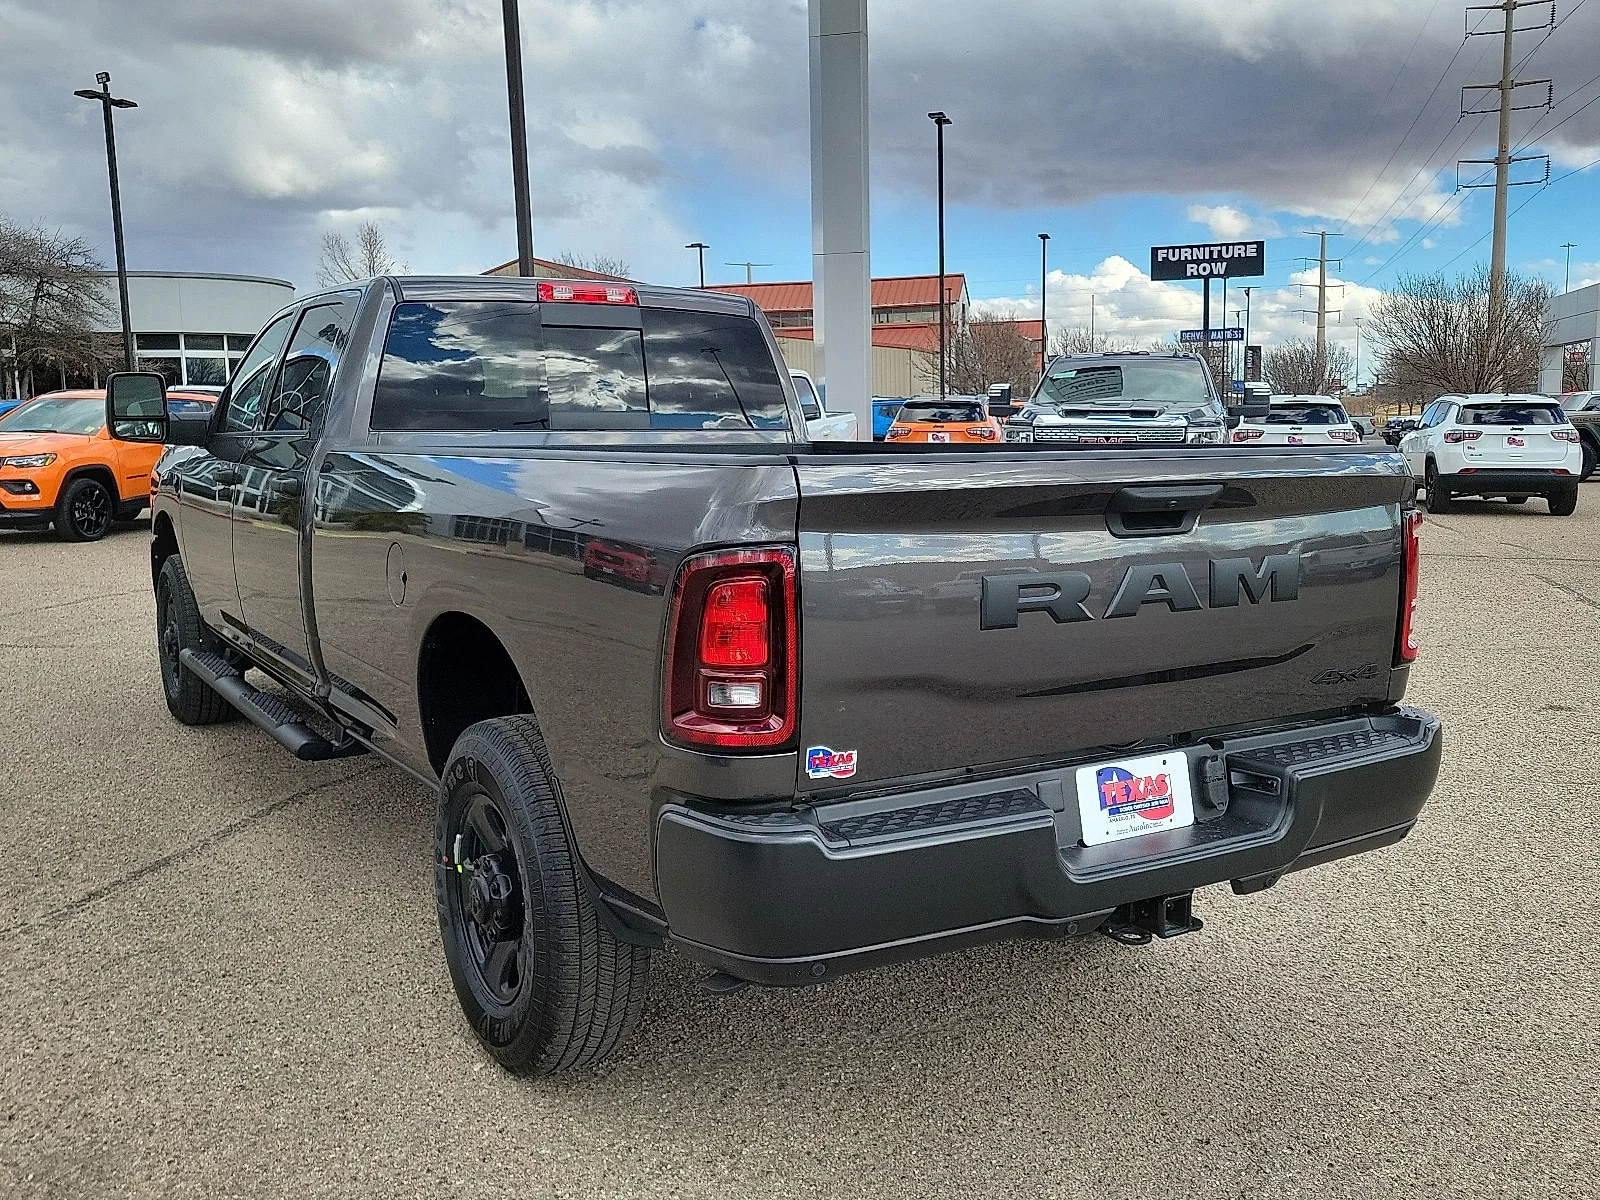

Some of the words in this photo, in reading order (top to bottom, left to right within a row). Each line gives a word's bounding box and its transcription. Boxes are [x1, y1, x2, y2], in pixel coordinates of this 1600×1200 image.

[1157, 244, 1258, 262] FURNITURE
[1186, 262, 1227, 276] ROW
[1182, 331, 1208, 341] DENVE
[980, 554, 1301, 631] RAM
[810, 752, 854, 769] TEXAS
[1101, 774, 1169, 805] TEXAS
